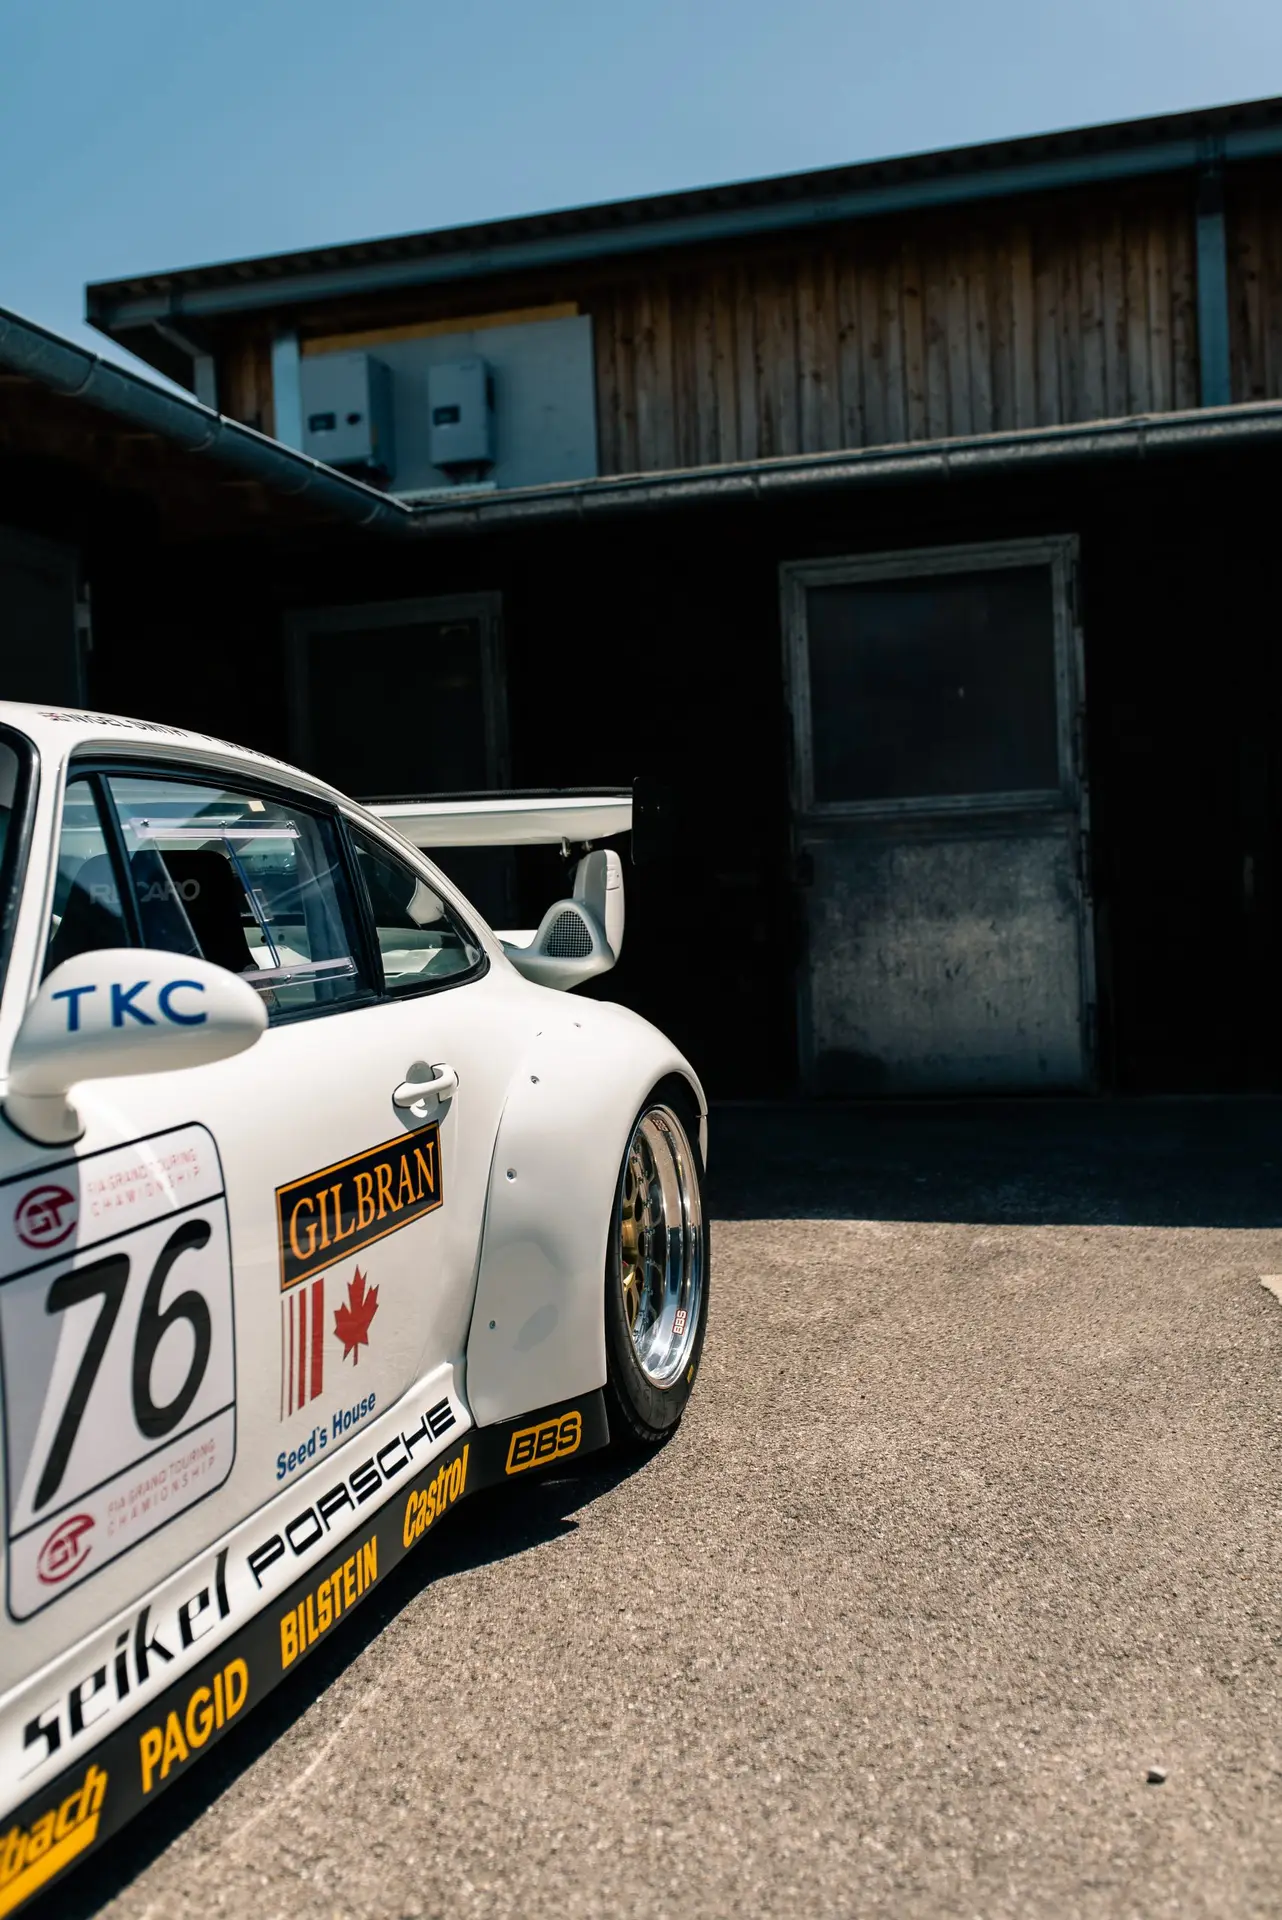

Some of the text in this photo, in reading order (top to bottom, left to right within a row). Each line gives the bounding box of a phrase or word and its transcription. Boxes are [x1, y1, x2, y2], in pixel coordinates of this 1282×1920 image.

[52, 979, 208, 1032] TKC
[288, 1140, 437, 1263] GILBRAN
[32, 1218, 212, 1513] 76
[673, 1309, 687, 1335] BBS
[332, 1391, 377, 1440] House
[505, 1411, 582, 1475] BBS
[247, 1396, 457, 1589] PORSCHE
[402, 1443, 470, 1549] Castrol
[280, 1534, 378, 1669] BILSTEIN
[139, 1656, 249, 1794] PAGID
[0, 1764, 108, 1889] bach
